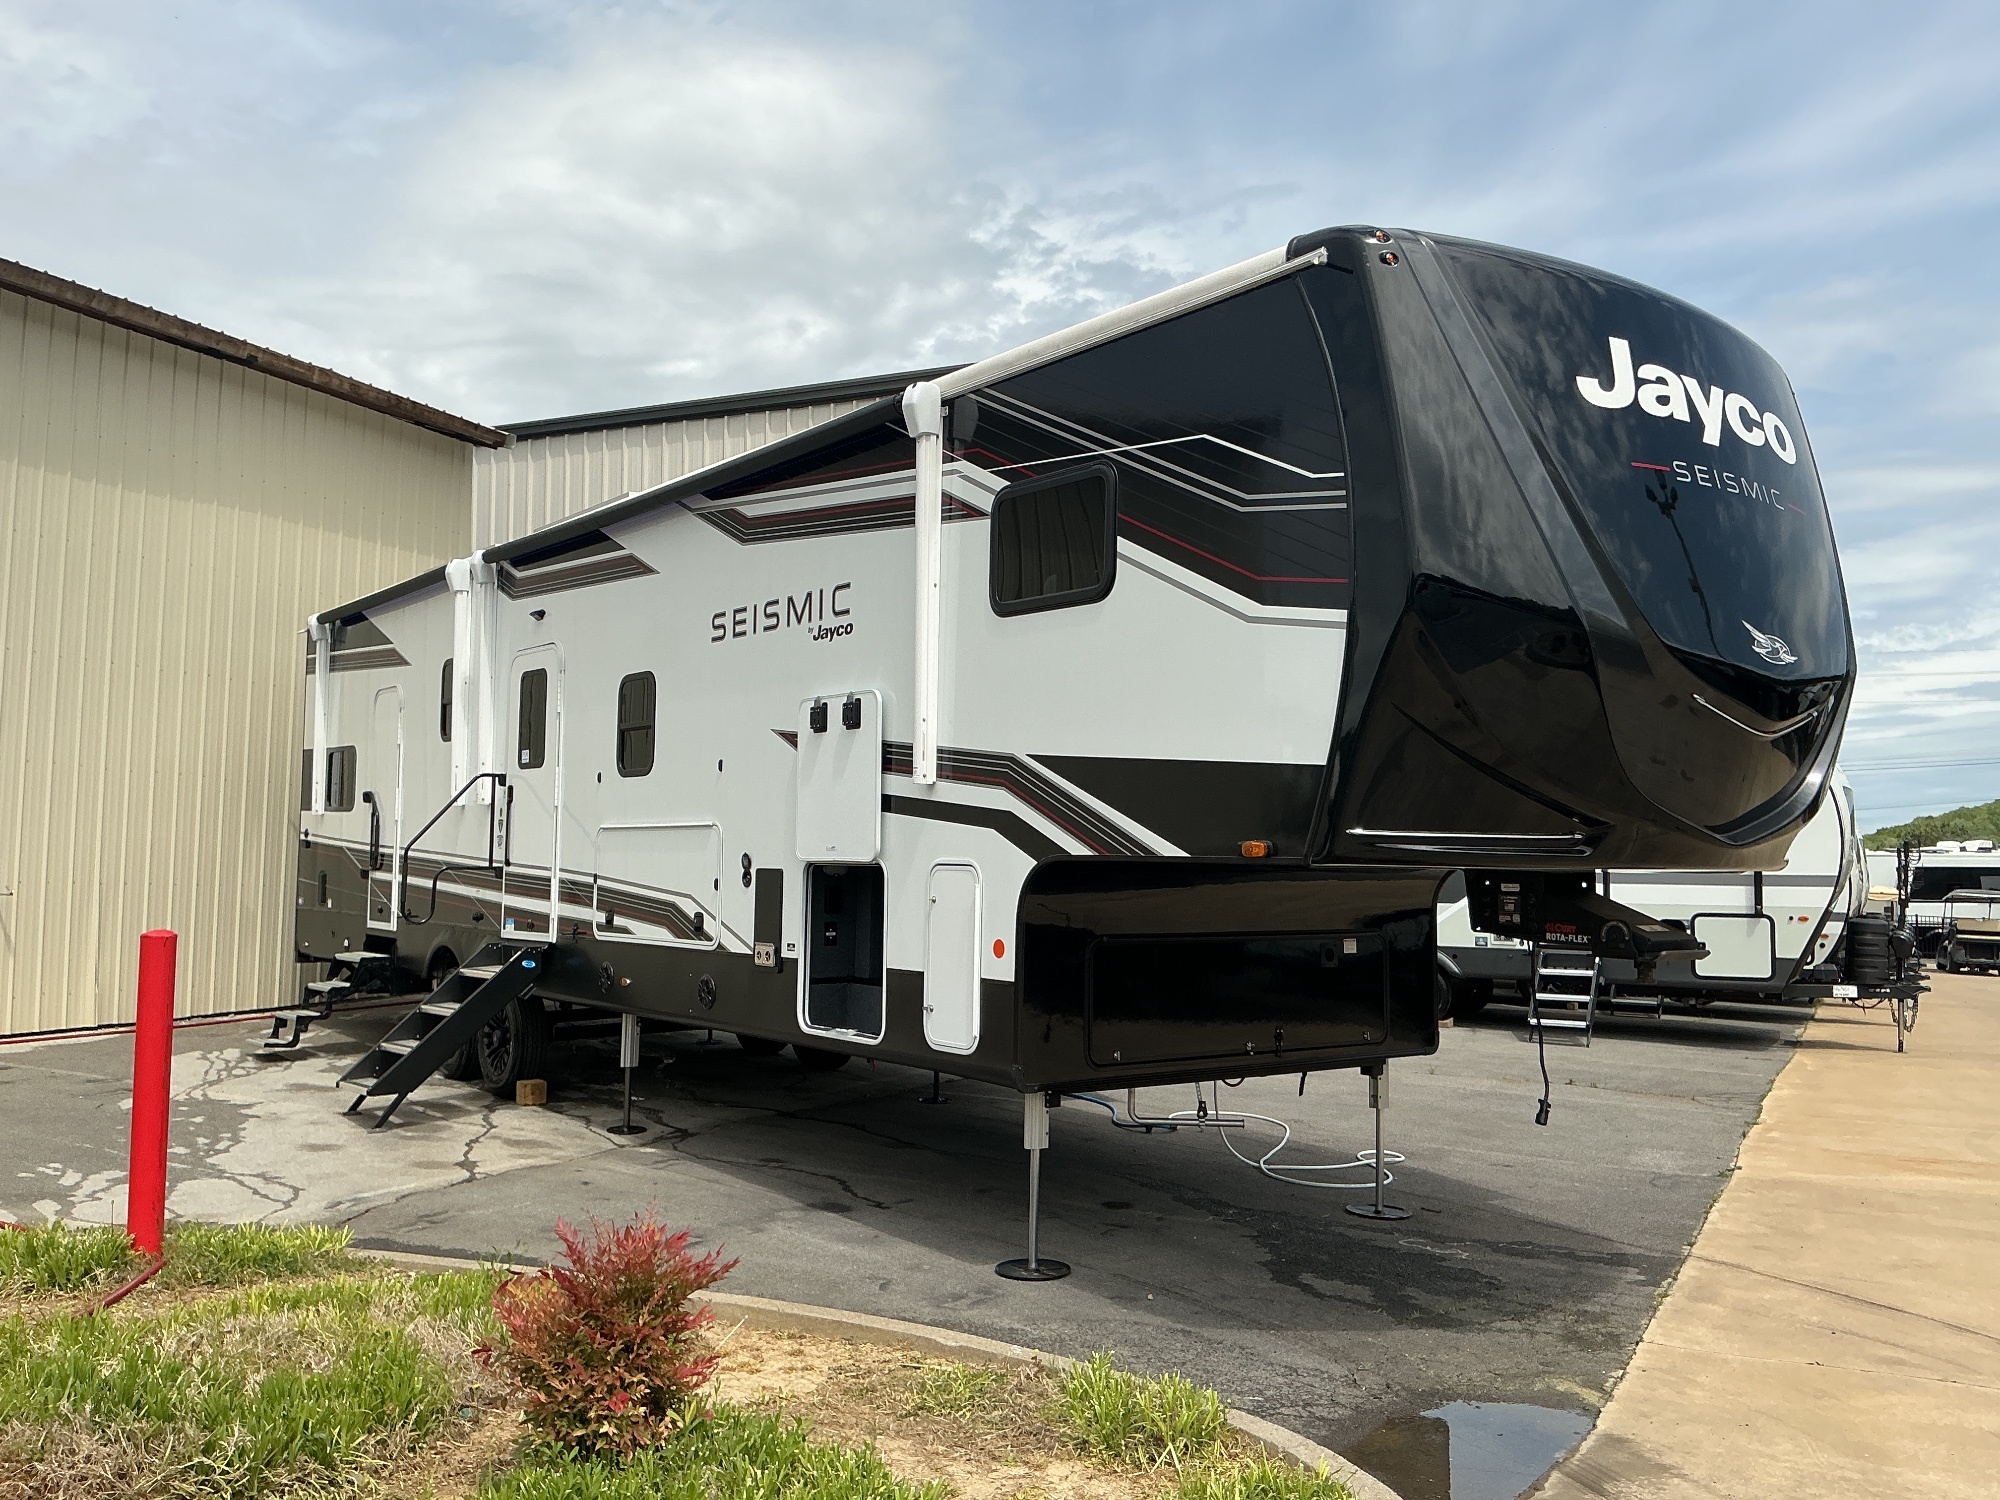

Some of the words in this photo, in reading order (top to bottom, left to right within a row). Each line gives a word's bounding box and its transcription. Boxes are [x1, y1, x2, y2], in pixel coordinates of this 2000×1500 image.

[1575, 336, 1797, 465] Jayco
[1672, 460, 1785, 510] SEISMIC
[711, 582, 851, 643] SEISMIC
[813, 622, 853, 642] Jayco
